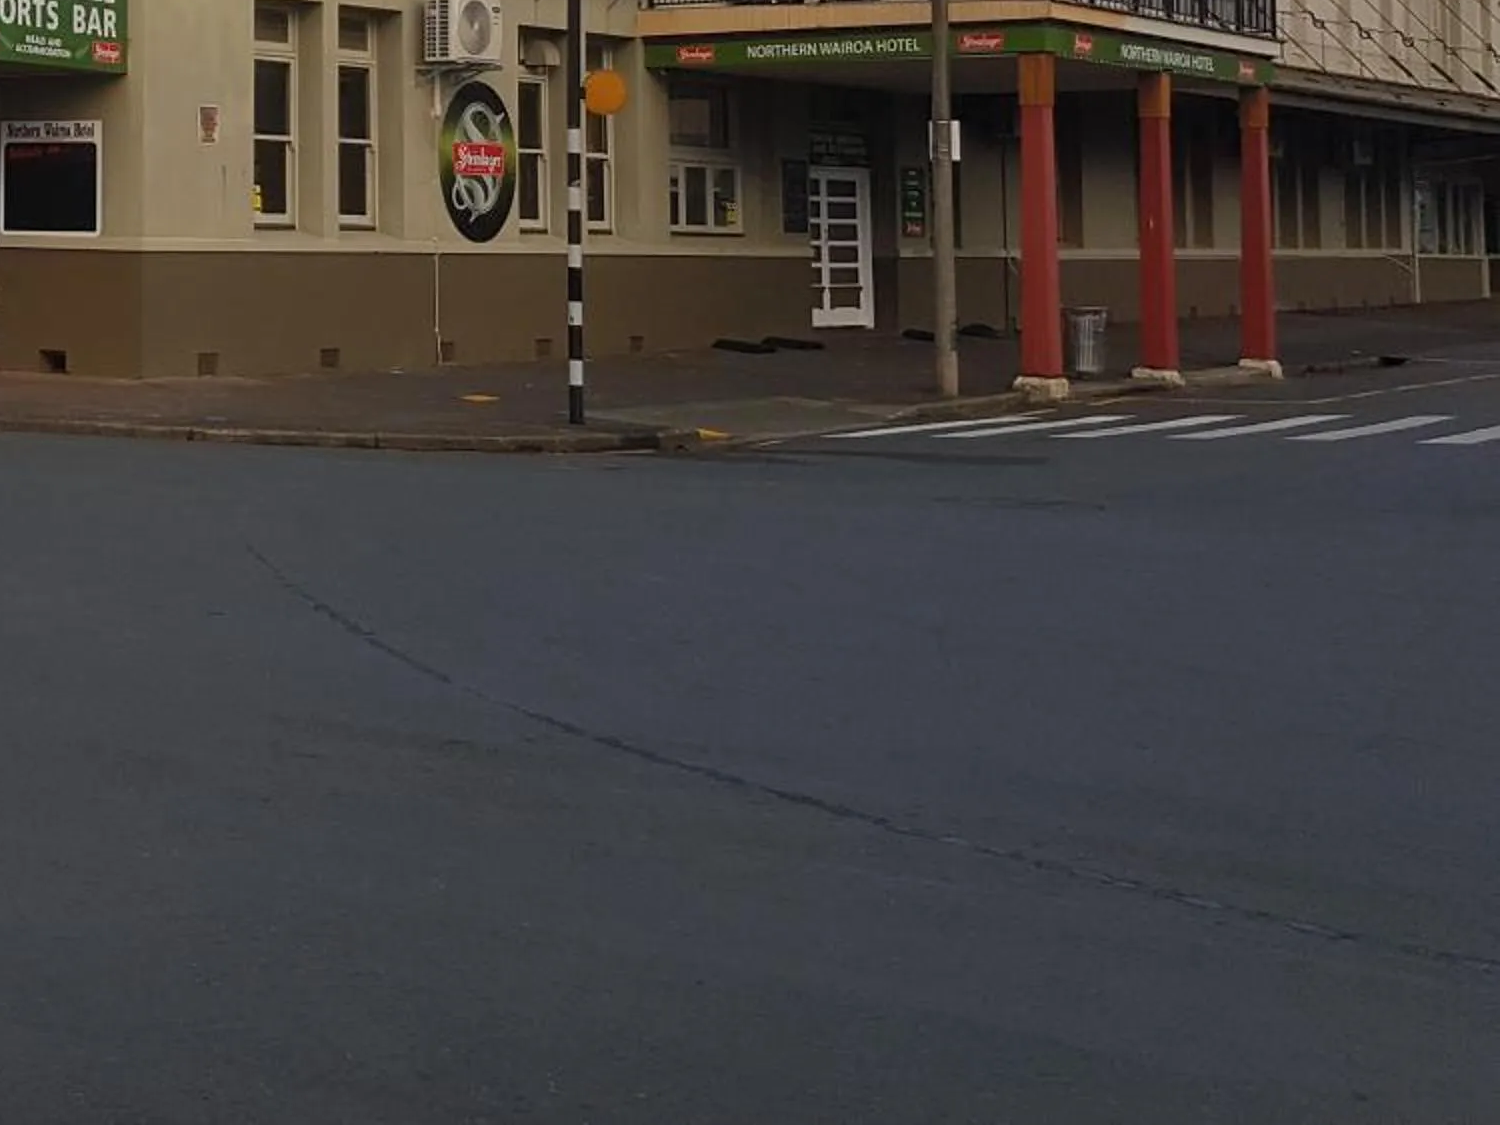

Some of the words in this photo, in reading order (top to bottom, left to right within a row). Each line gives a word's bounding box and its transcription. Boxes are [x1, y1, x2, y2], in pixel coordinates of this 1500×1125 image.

[72, 3, 117, 39] BAR
[747, 44, 819, 60] NORTHERN
[819, 40, 874, 56] WAIROA
[876, 38, 921, 53] HOTEL
[1120, 43, 1162, 65] NORTHERN
[74, 122, 95, 137] Hotel
